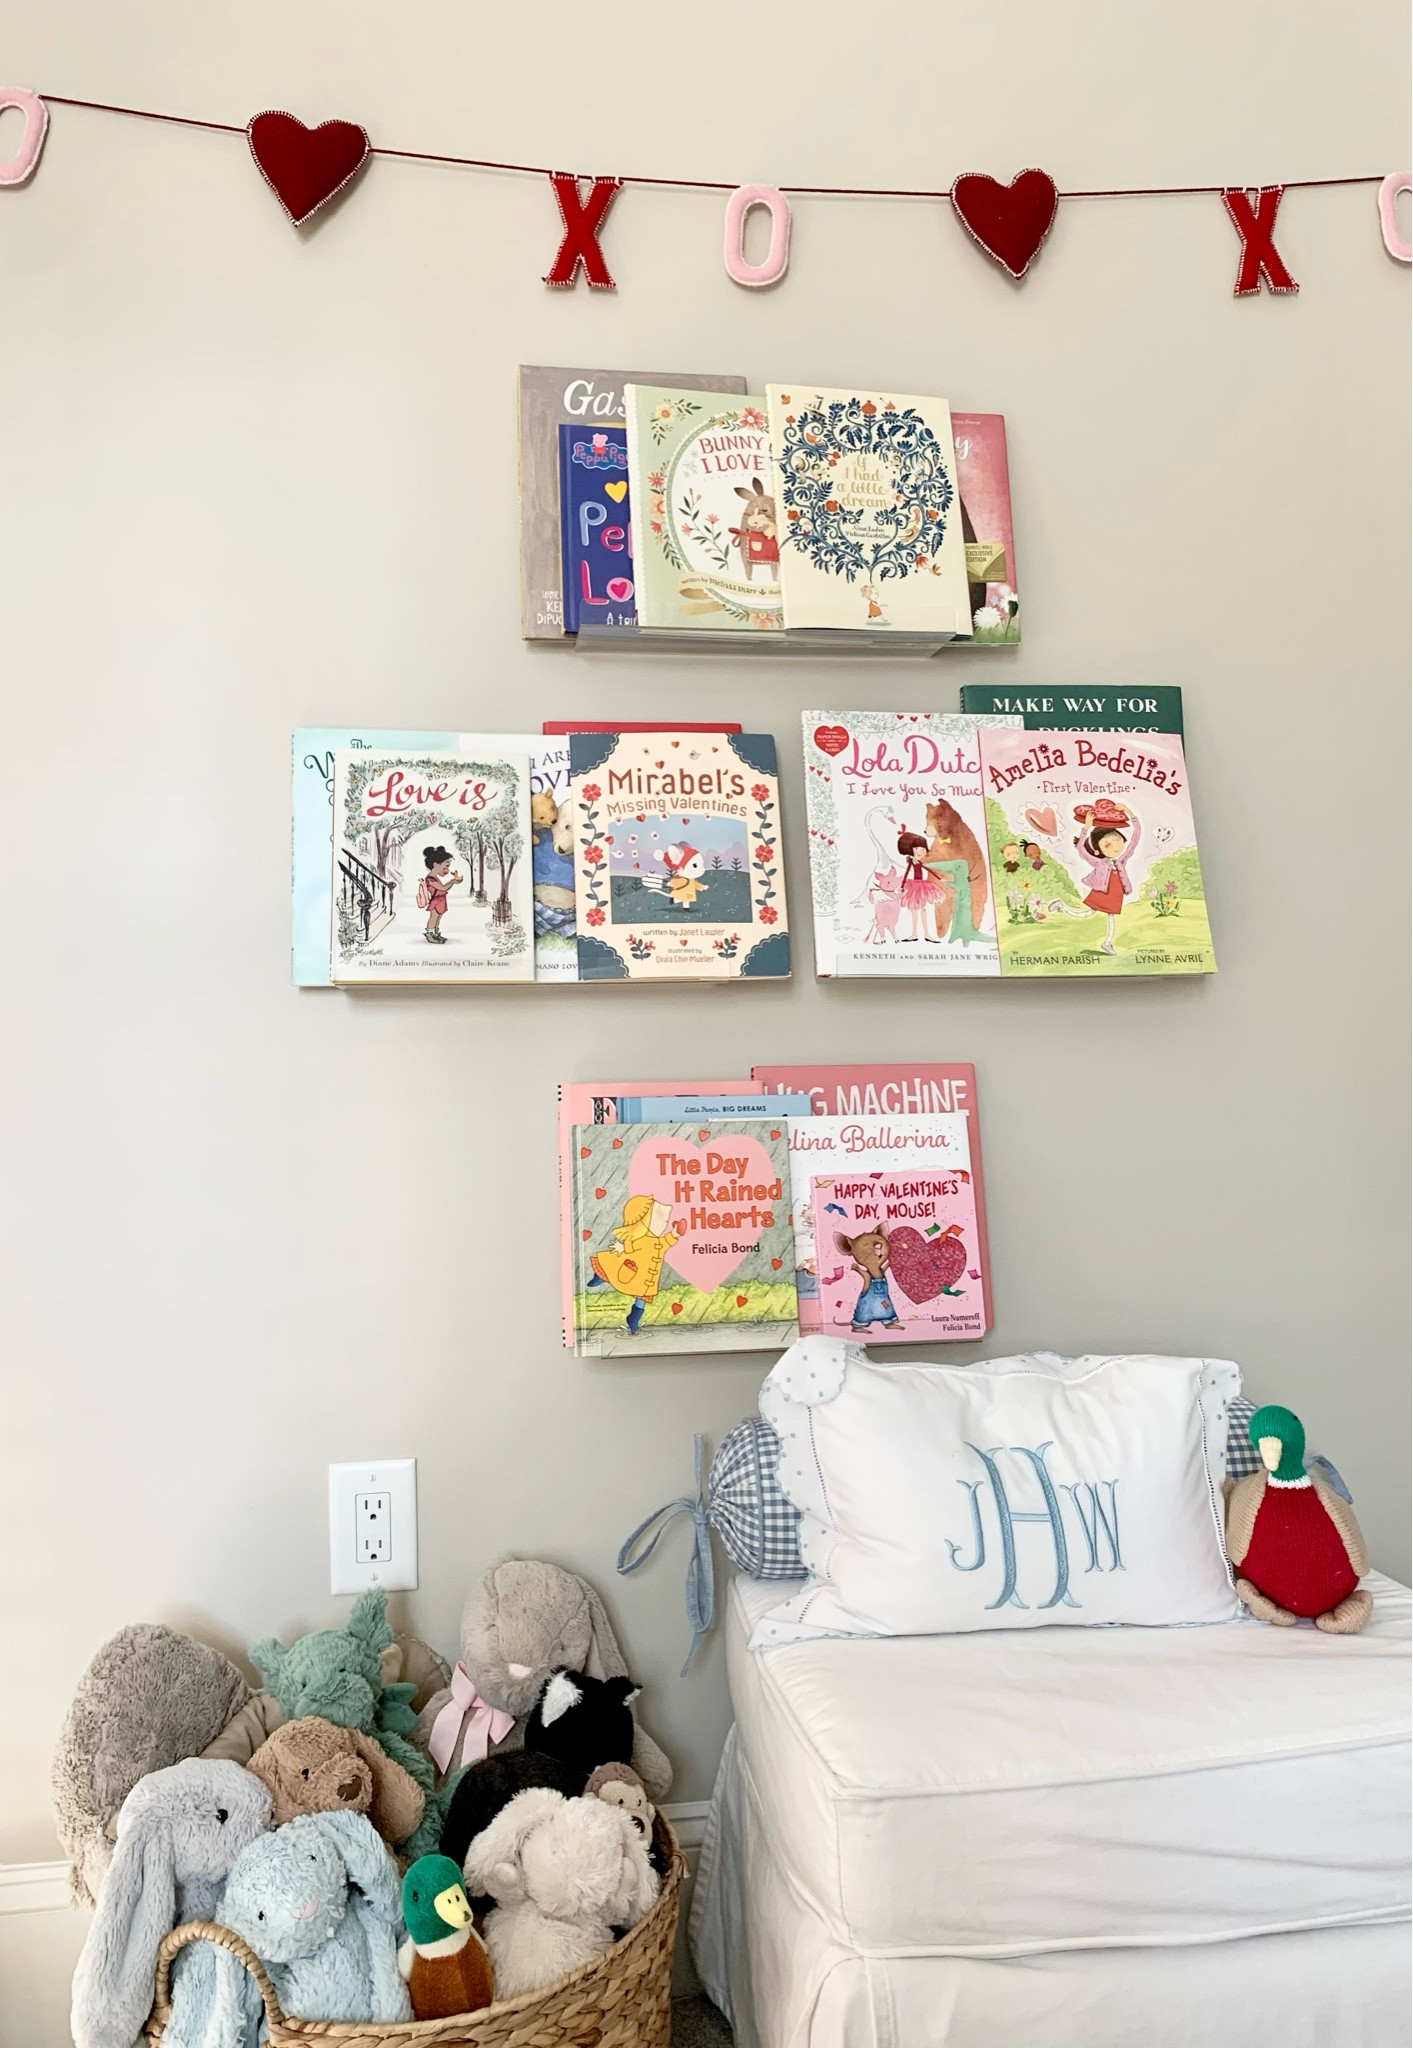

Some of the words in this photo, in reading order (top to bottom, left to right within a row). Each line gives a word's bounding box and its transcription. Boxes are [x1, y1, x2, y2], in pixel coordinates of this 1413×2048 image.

[542, 170, 624, 288] X
[724, 183, 791, 287] O
[1220, 185, 1300, 297] X
[575, 444, 609, 466] Peppa
[699, 435, 764, 454] BUNNY
[701, 458, 712, 474] I
[715, 453, 765, 472] LOVE
[853, 467, 882, 481] had
[836, 483, 846, 493] a
[850, 481, 888, 495] little
[841, 492, 890, 508] dream
[579, 501, 633, 559] Pe
[709, 577, 737, 591] Melissa
[993, 698, 1054, 713] MAKE
[1063, 698, 1107, 713] WAY
[1116, 698, 1158, 713] FOR
[842, 738, 904, 779] Lola
[903, 734, 982, 775] Dutc
[988, 743, 1067, 794] Amelia
[1074, 739, 1182, 796] Bedelia's
[608, 767, 746, 796] Mirabel's
[847, 782, 857, 795] I
[862, 781, 897, 797] Love
[900, 783, 927, 802] You
[931, 783, 946, 797] So
[1042, 780, 1072, 794] First
[1075, 780, 1131, 795] Valentine
[366, 771, 457, 817] Love
[459, 779, 498, 811] is
[606, 796, 667, 817] Missing
[669, 796, 749, 817] Valentines
[669, 929, 678, 937] by
[679, 928, 699, 937] Janet
[674, 955, 689, 963] Chin
[689, 955, 715, 963] Mueller
[1010, 955, 1060, 965] HERMAN
[1062, 954, 1101, 965] PARISH
[1135, 954, 1172, 964] LYNNE
[1174, 953, 1204, 963] AVRIL
[836, 1077, 970, 1117] MACHINE
[722, 1105, 736, 1113] BIG
[737, 1105, 767, 1113] DREAMS
[840, 1124, 950, 1154] Ballerina
[656, 1153, 701, 1176] The
[706, 1152, 749, 1179] Day
[674, 1180, 695, 1203] It
[699, 1177, 783, 1203] Rained
[834, 1183, 876, 1200] HAPPY
[880, 1179, 959, 1200] VALENTINE'S
[690, 1205, 776, 1230] Hearts
[855, 1203, 880, 1220] DAY,
[886, 1201, 936, 1219] MOUSE!
[691, 1243, 728, 1255] Felicia
[731, 1242, 760, 1253] Bond
[942, 1323, 963, 1331] Felicia
[964, 1322, 981, 1330] Bond
[950, 1312, 980, 1321] Numeroff
